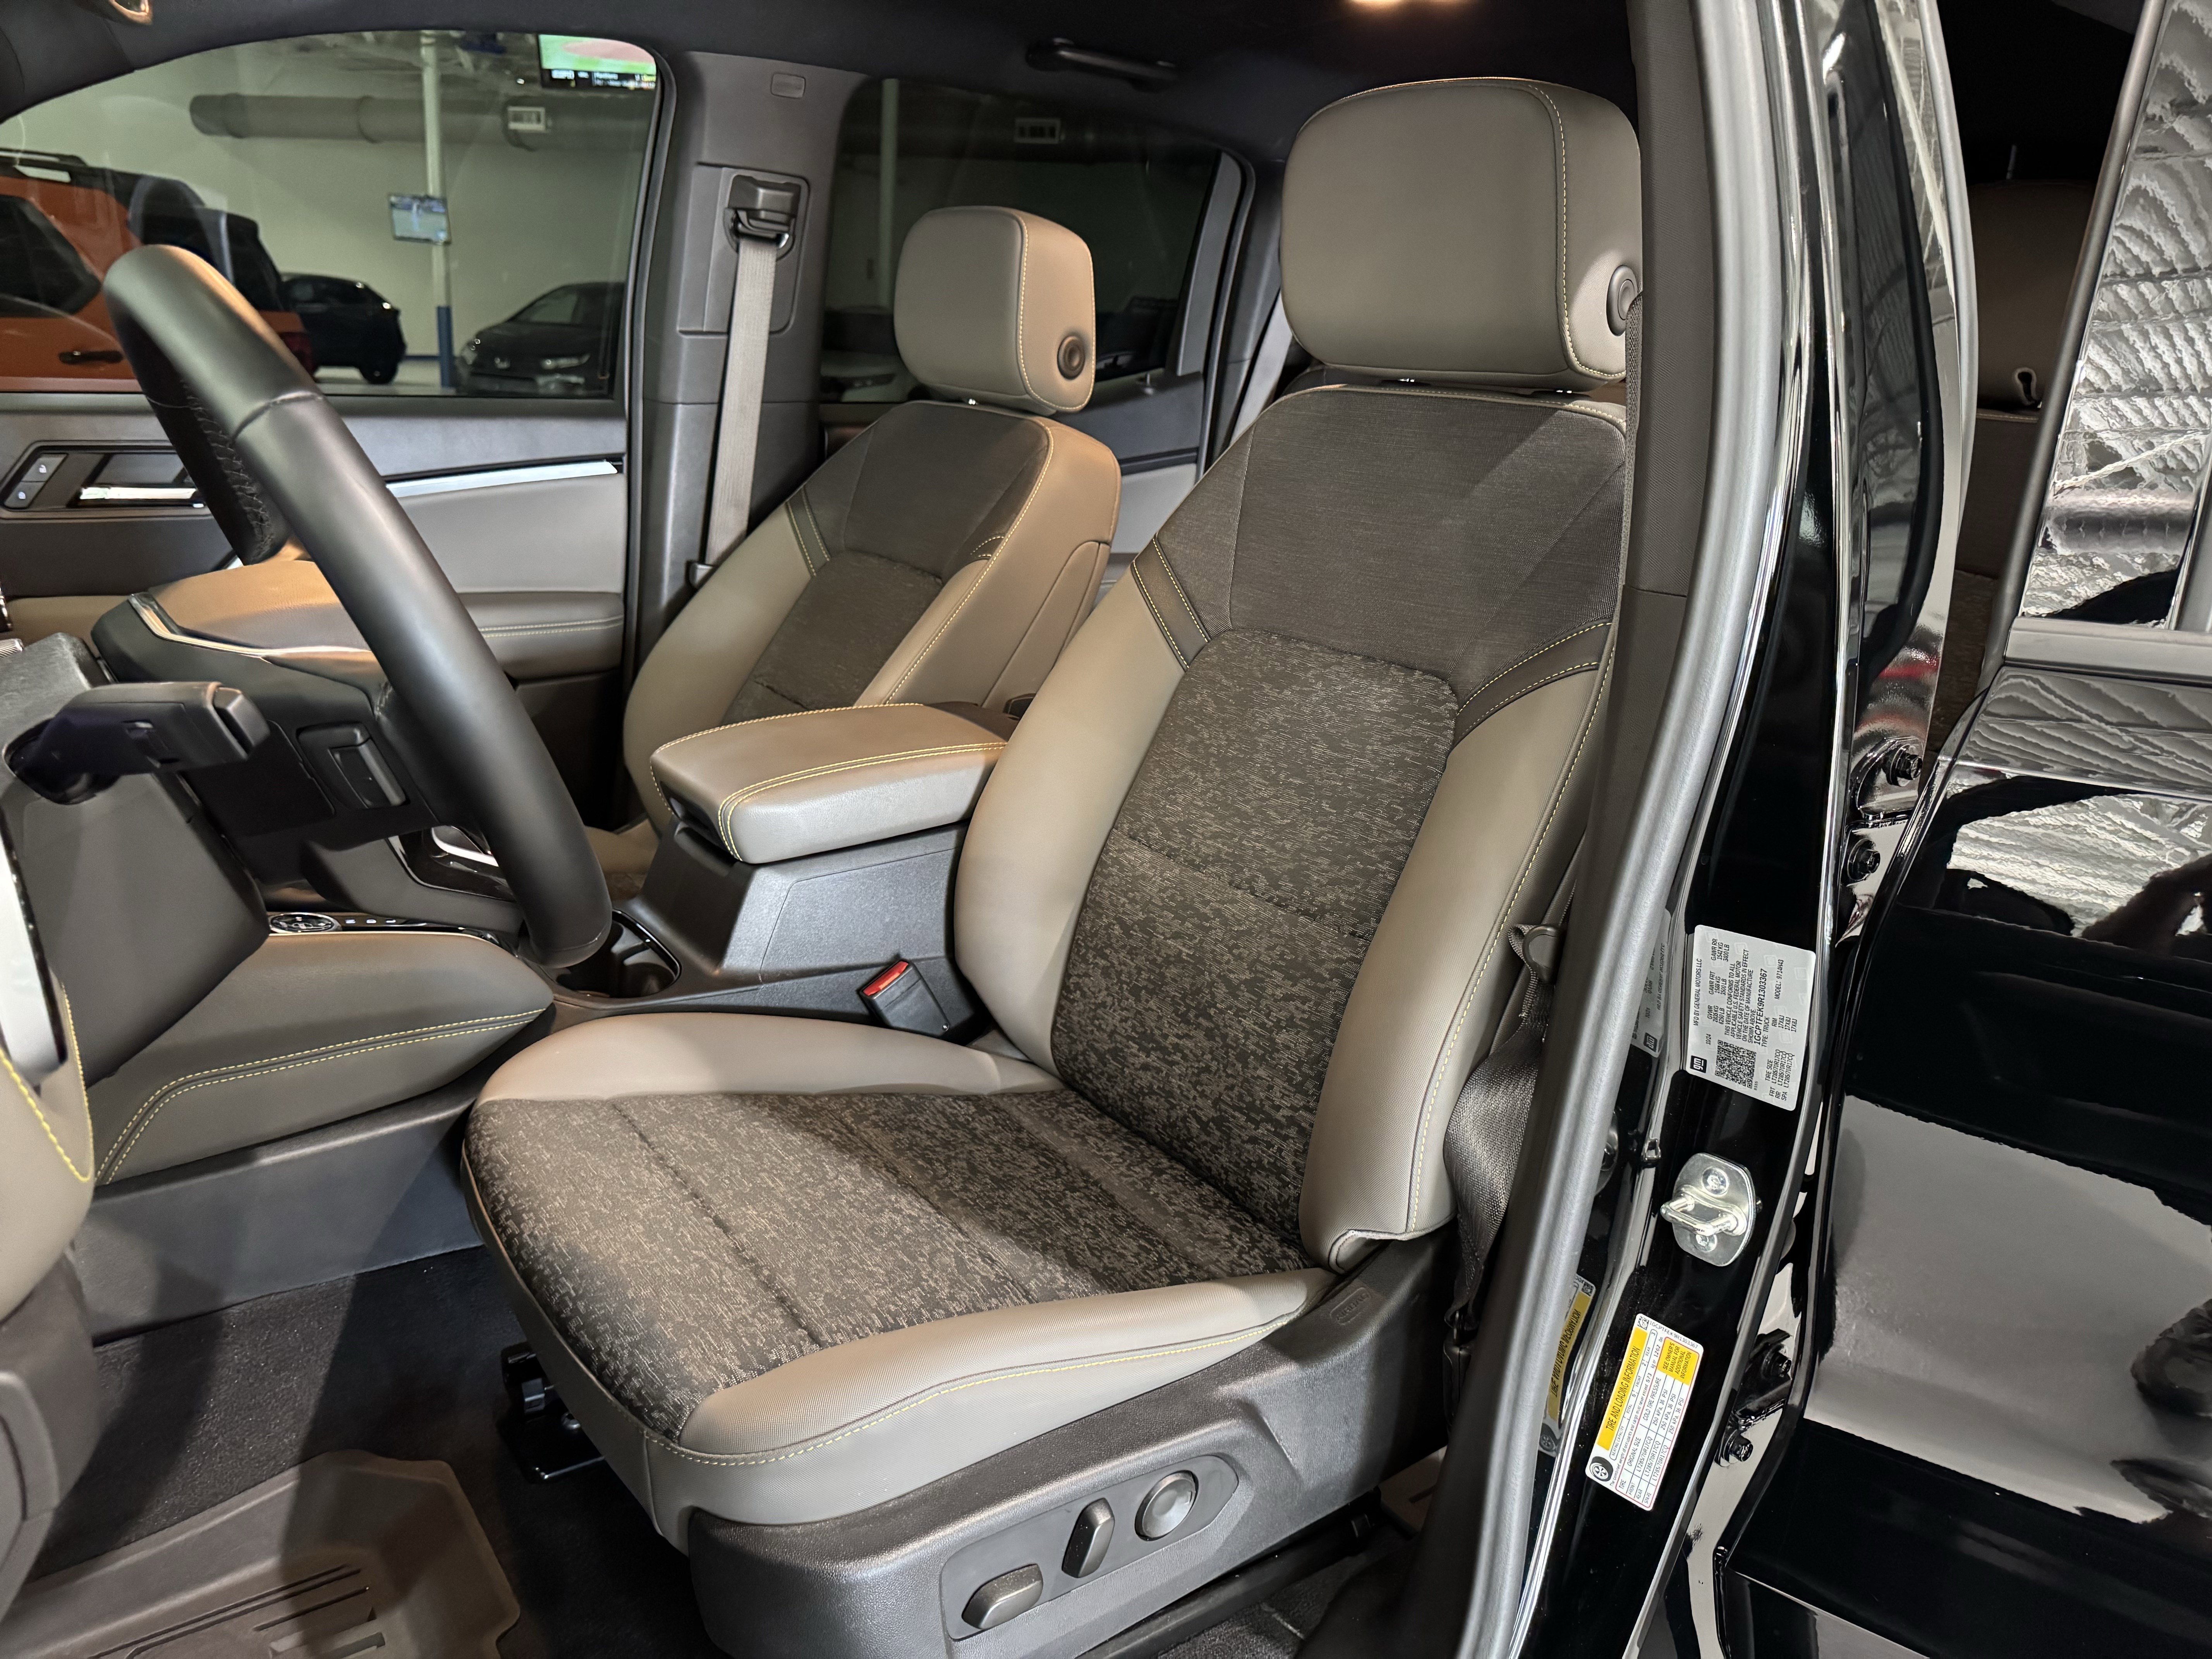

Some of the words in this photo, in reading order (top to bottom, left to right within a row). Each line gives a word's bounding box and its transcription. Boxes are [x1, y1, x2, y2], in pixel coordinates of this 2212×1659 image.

[1745, 969, 1753, 1004] MANUFACTURE
[1753, 969, 1767, 1044] 1GCPTFEK9R1303367
[1693, 1058, 1704, 1070] gm
[1622, 1346, 1640, 1383] INFORMATION
[1668, 1355, 1677, 1372] MANUAL
[1674, 1351, 1685, 1374] ADDITIONAL
[1680, 1351, 1692, 1379] INFORMATION
[1614, 1381, 1628, 1407] LOADING
[1642, 1408, 1650, 1420] COLD
[1650, 1377, 1661, 1399] PRESSURE
[1606, 1417, 1616, 1431] TIRE
[1610, 1405, 1620, 1419] AND
